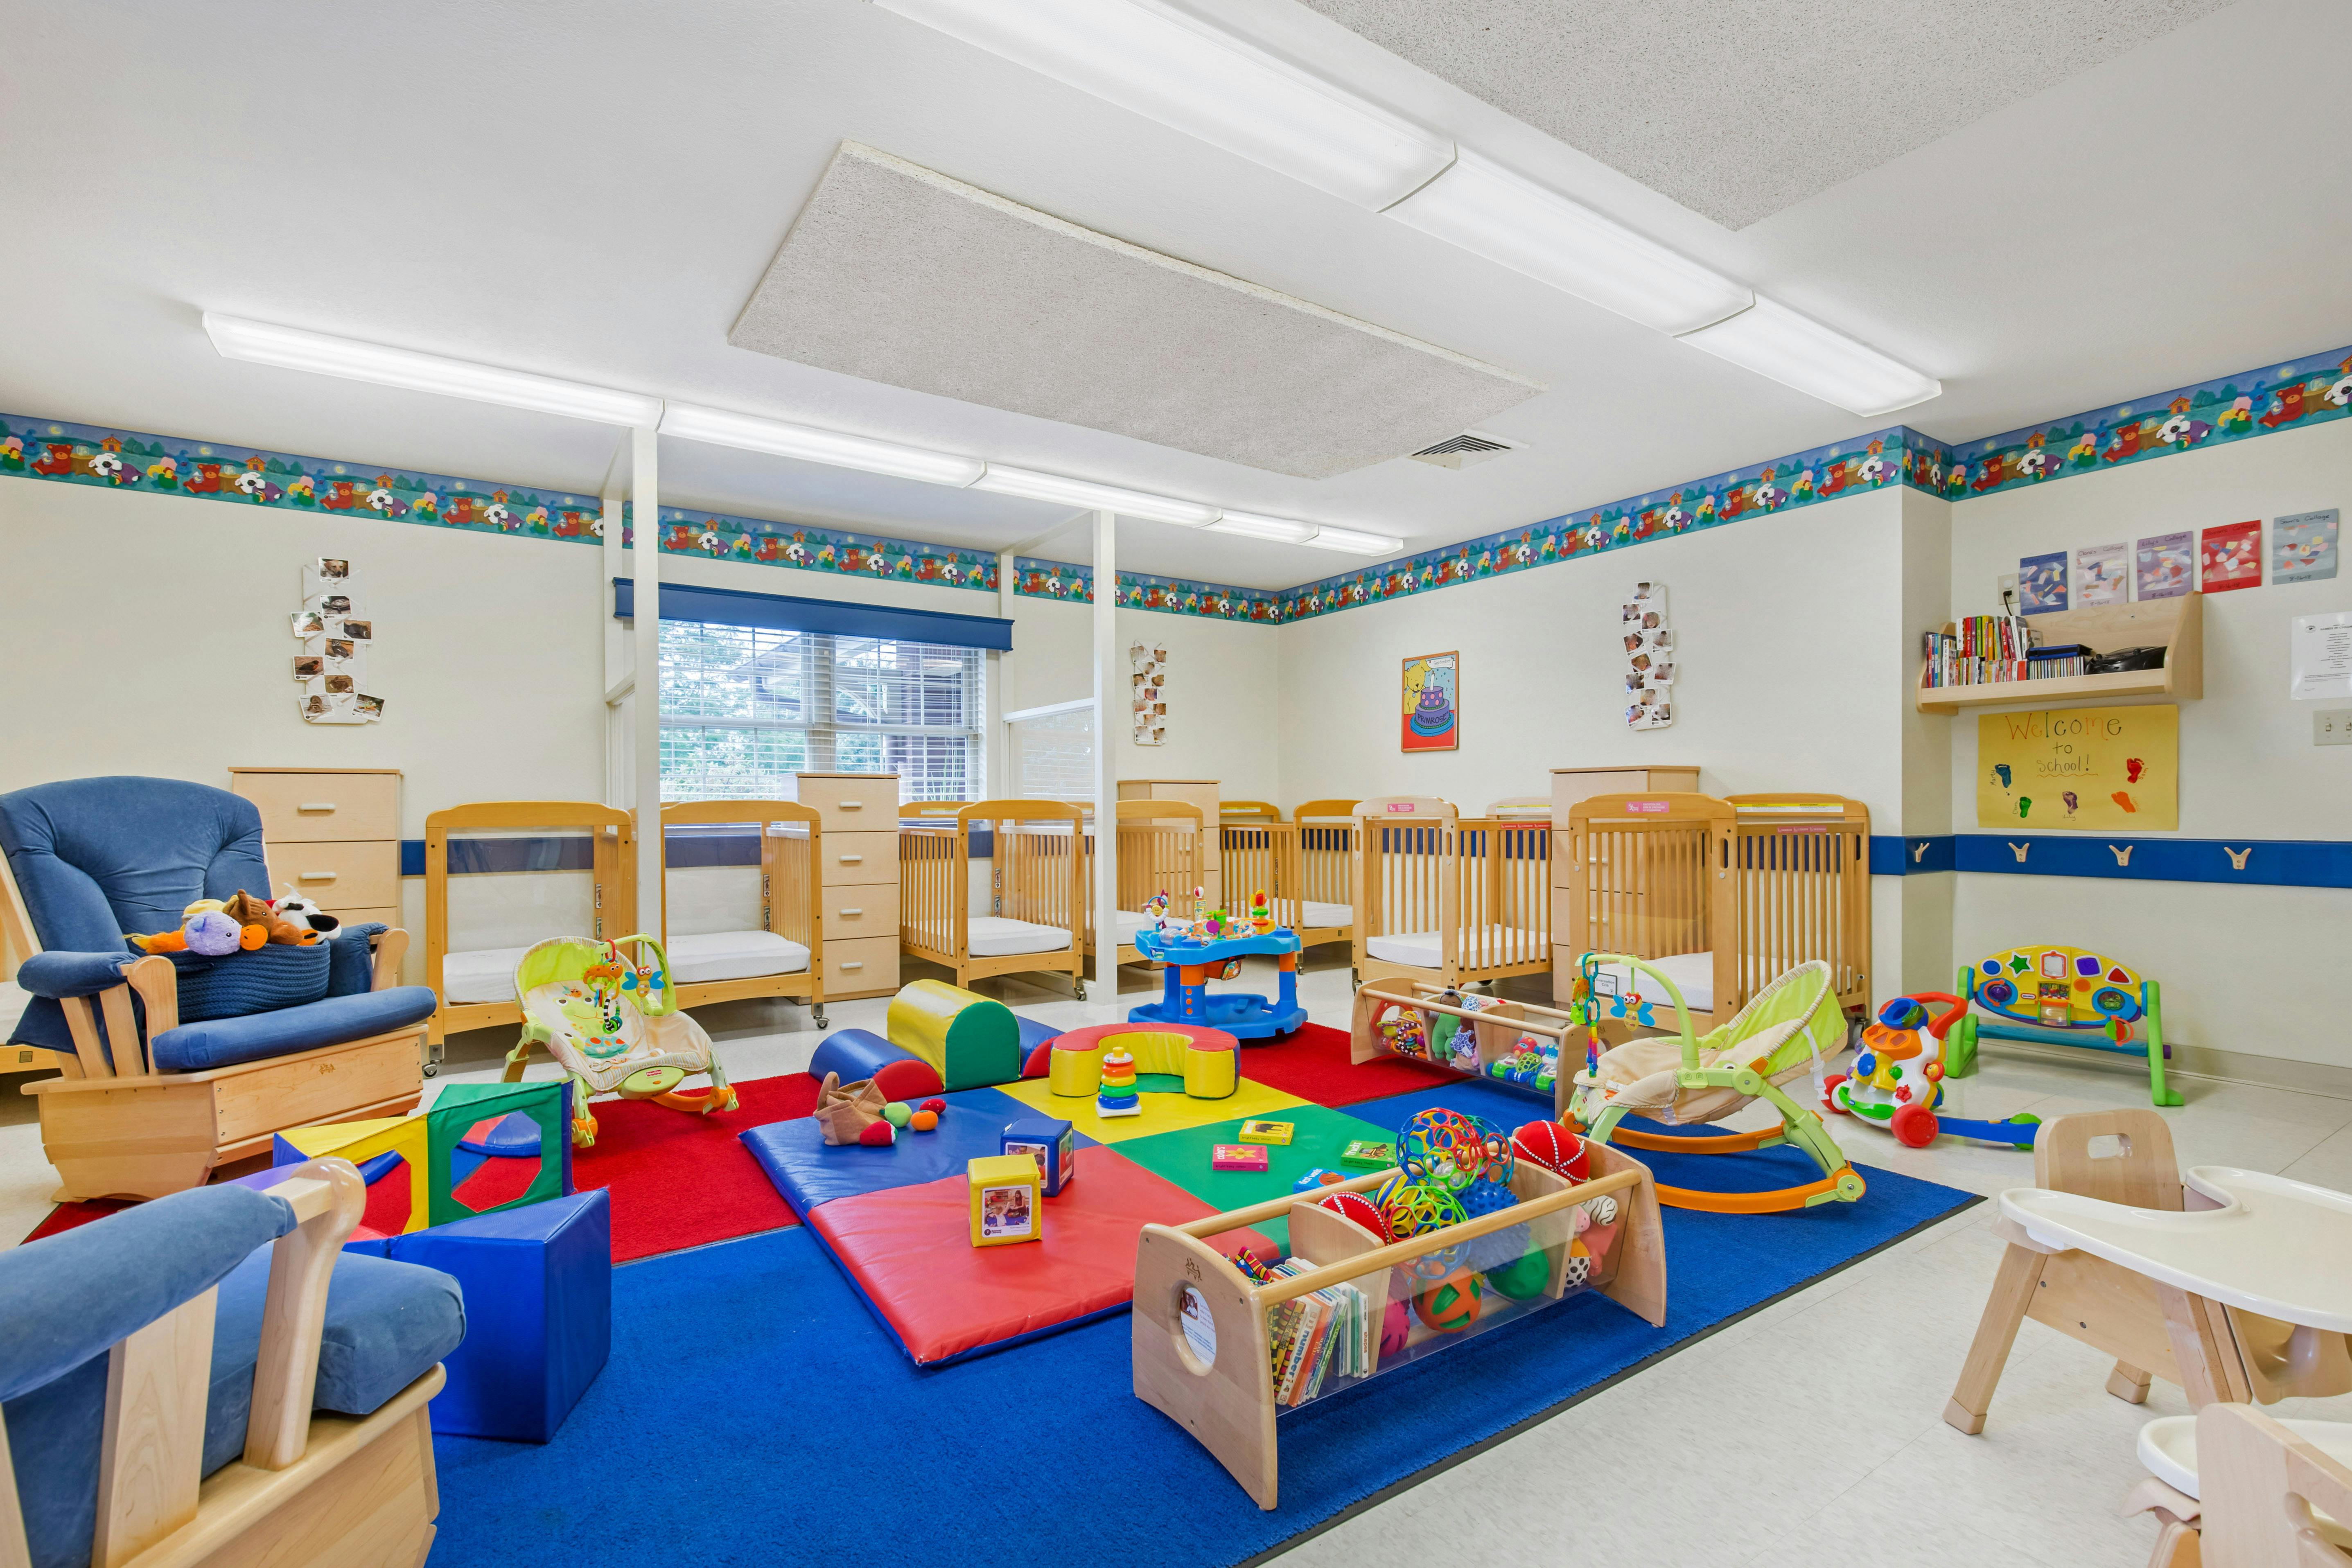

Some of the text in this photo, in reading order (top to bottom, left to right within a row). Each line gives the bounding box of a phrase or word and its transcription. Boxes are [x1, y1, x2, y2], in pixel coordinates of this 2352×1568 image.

[2165, 534, 2187, 542] Collage
[1417, 712, 1447, 725] PRIMROSE
[2005, 712, 2122, 740] Welcome
[2052, 742, 2072, 754] to
[2138, 767, 2149, 780] Sam
[1214, 1146, 1226, 1160] colors
